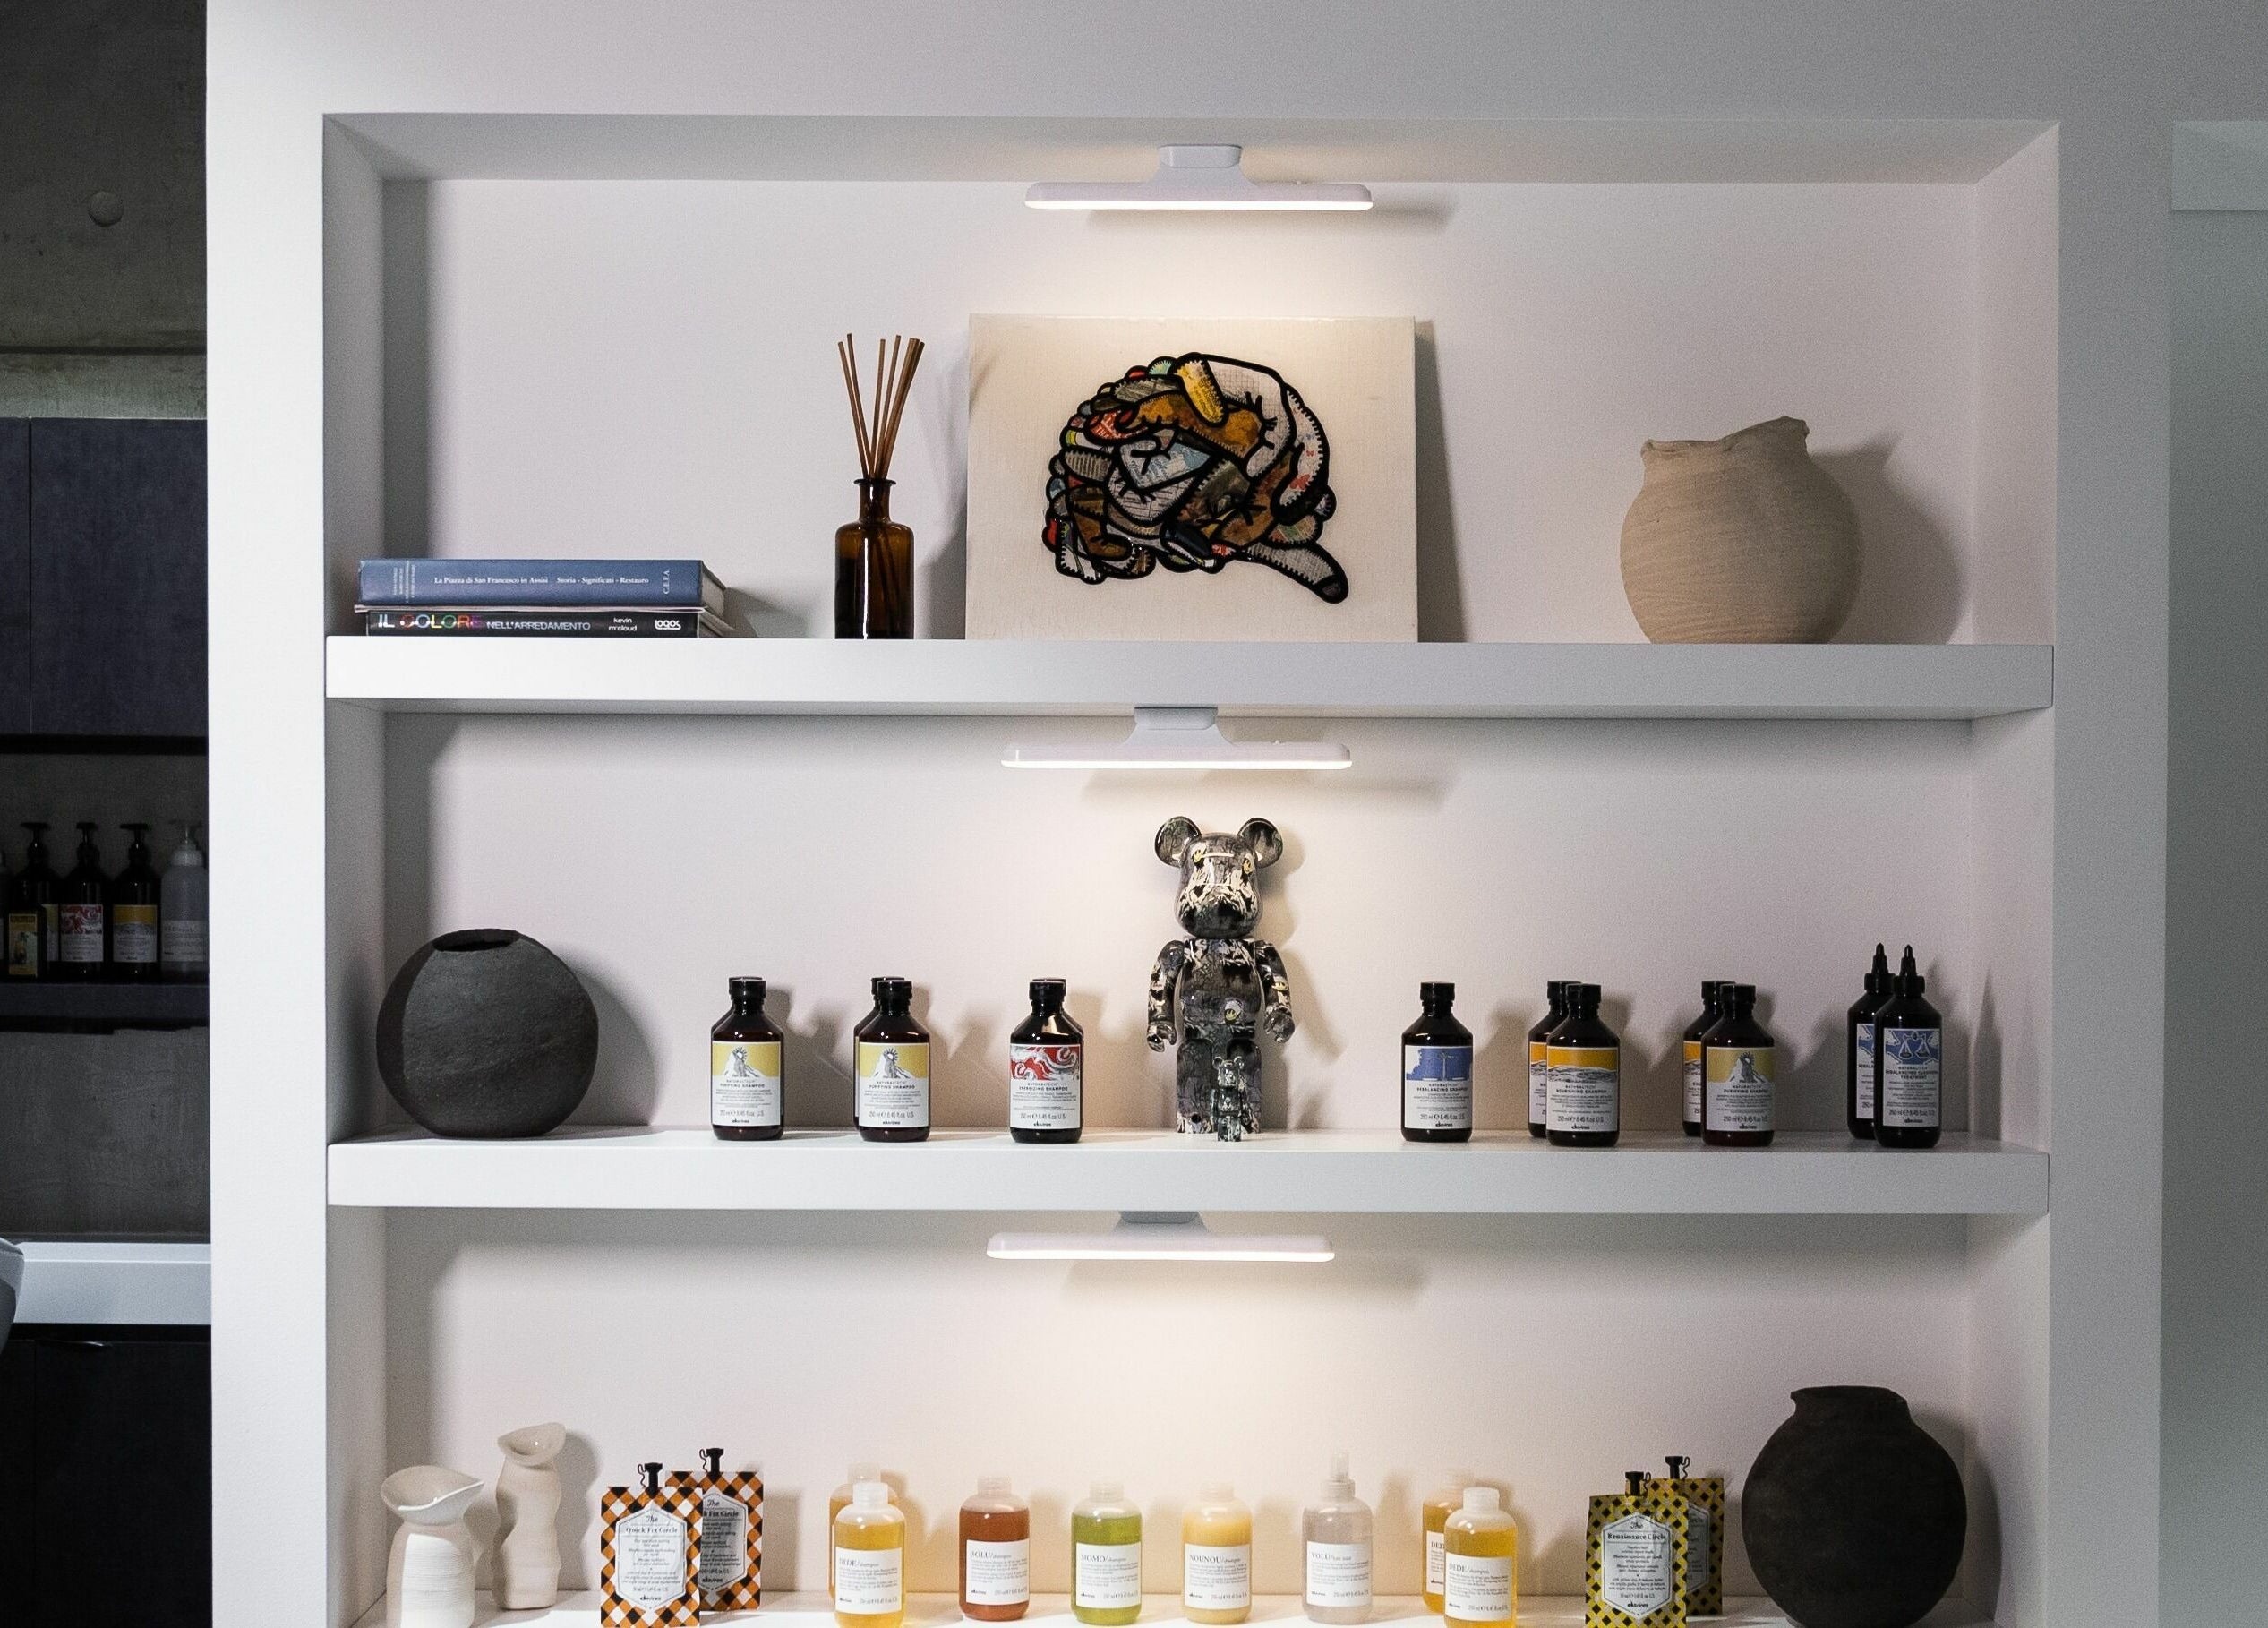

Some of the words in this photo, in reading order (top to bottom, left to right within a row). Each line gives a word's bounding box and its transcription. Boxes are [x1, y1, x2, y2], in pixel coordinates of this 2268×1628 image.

[444, 577, 465, 585] Piazza
[581, 577, 614, 585] Significati
[378, 614, 395, 628] IL
[399, 614, 484, 630] COLORE
[486, 621, 592, 630] NELL'ARREDAMENTO
[1607, 1532, 1647, 1540] Renaissance
